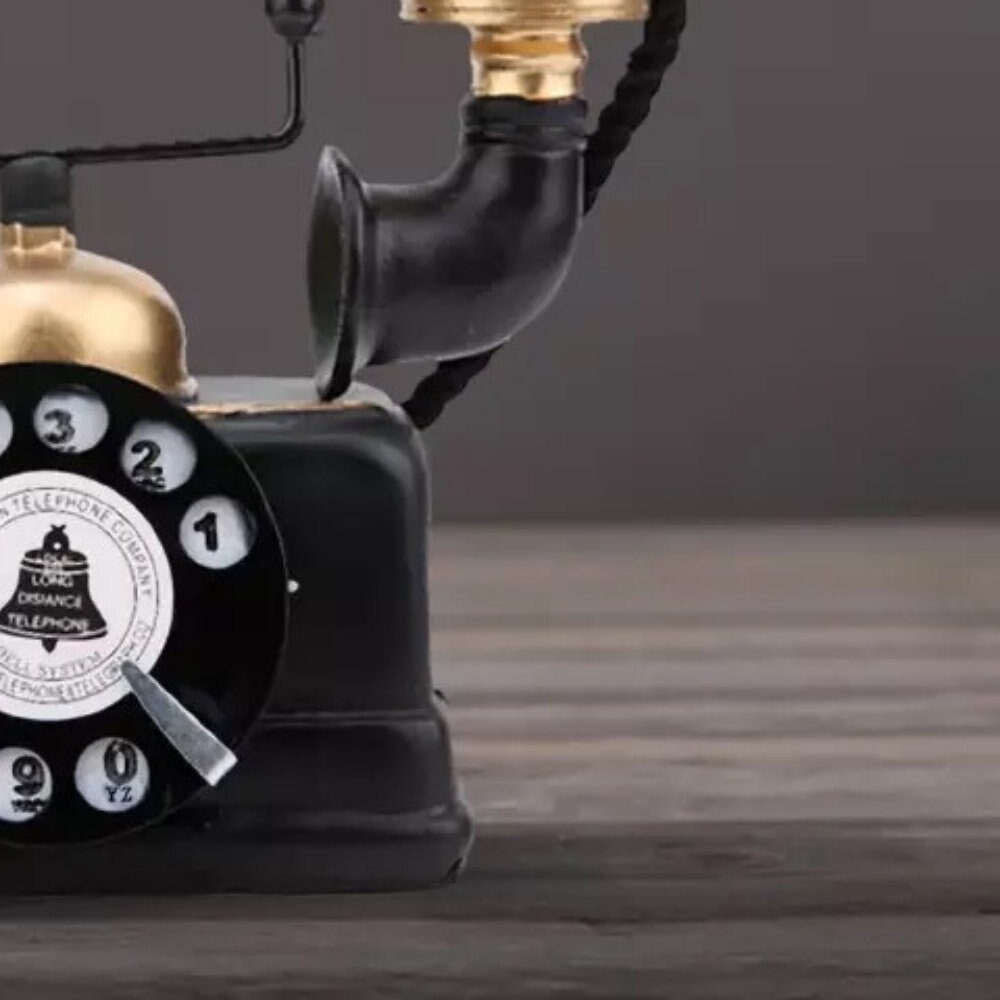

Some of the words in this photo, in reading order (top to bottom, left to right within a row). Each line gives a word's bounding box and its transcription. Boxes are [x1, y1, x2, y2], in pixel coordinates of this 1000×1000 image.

[44, 408, 76, 444] 3
[131, 439, 164, 478] 2
[12, 492, 113, 523] TELEPHONE
[111, 519, 152, 597] COMPANY
[193, 512, 219, 553] 1
[31, 573, 74, 588] LONG
[7, 612, 89, 633] TELEPHONE
[12, 755, 46, 797] 9
